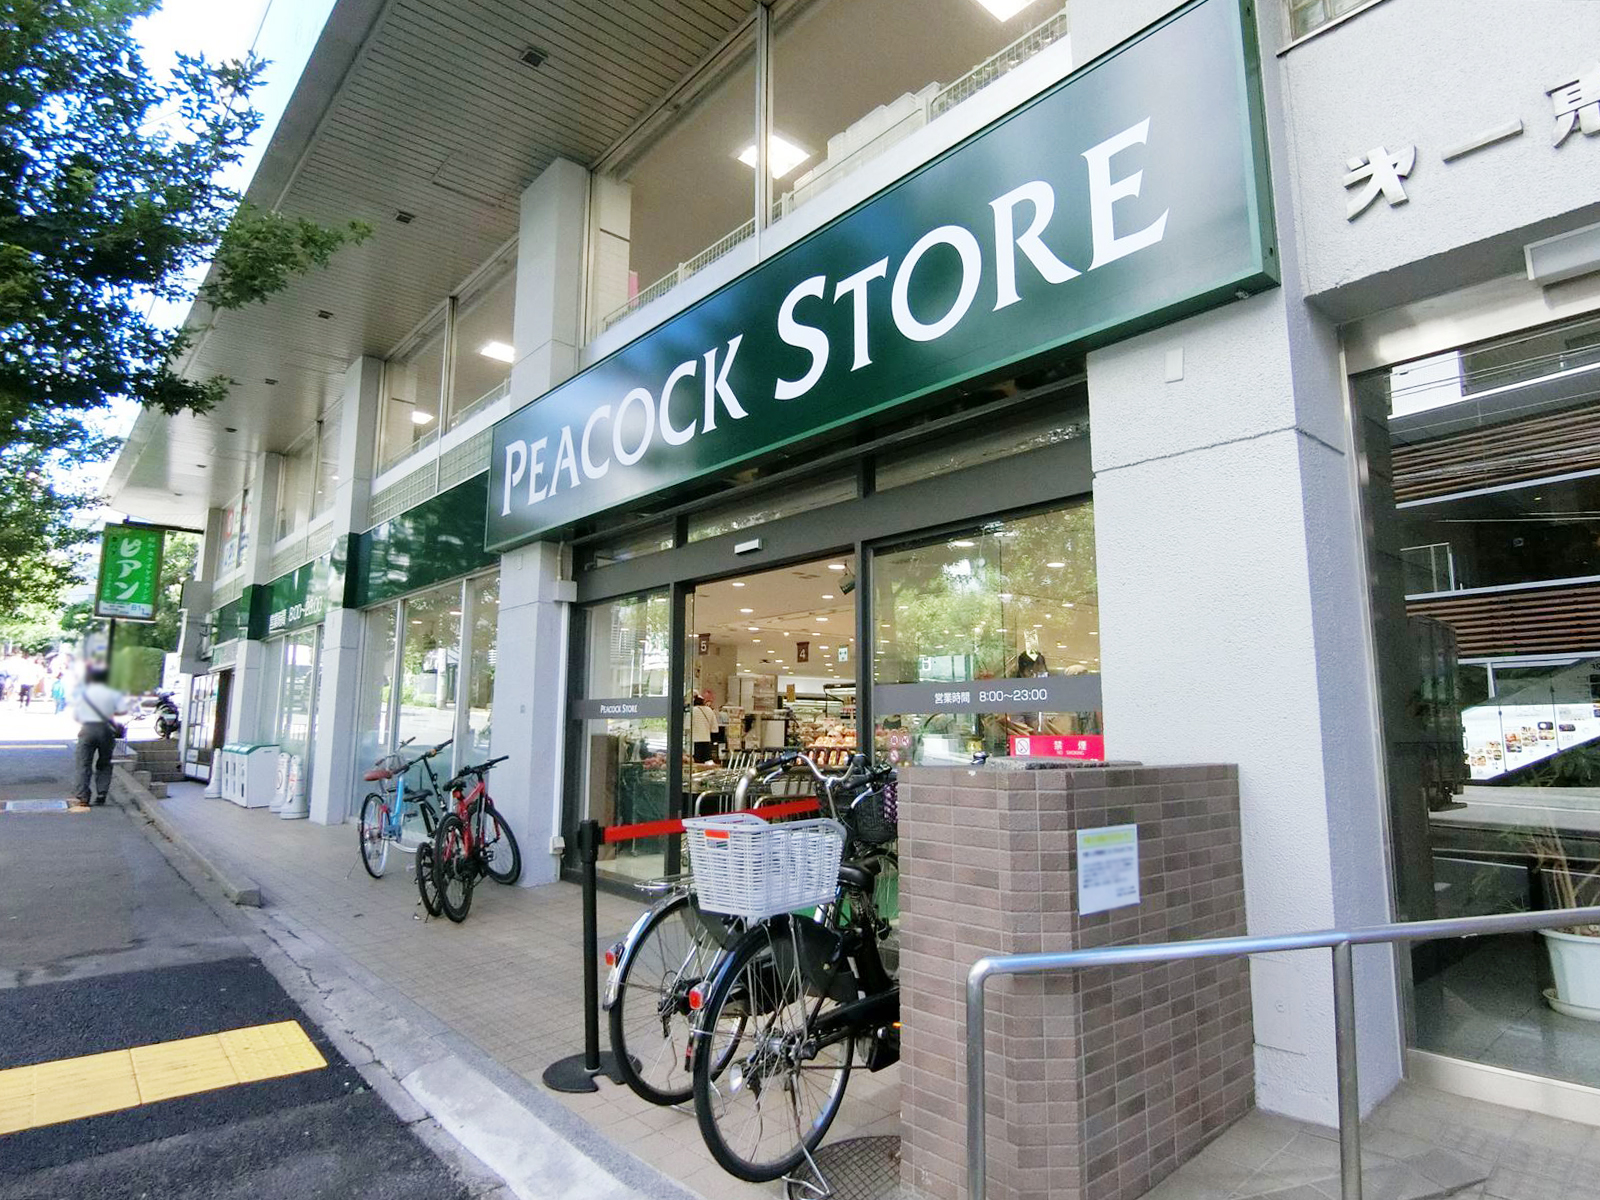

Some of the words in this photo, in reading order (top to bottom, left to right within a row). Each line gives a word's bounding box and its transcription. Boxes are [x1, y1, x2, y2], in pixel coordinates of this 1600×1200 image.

[500, 333, 749, 517] PEACOCK
[774, 116, 1169, 400] STORE
[114, 537, 142, 600] ピアン
[700, 640, 707, 652] 5
[799, 648, 806, 659] 4
[934, 691, 971, 704] 営業時間
[600, 704, 621, 713] PEACOCK
[622, 703, 638, 713] STORE
